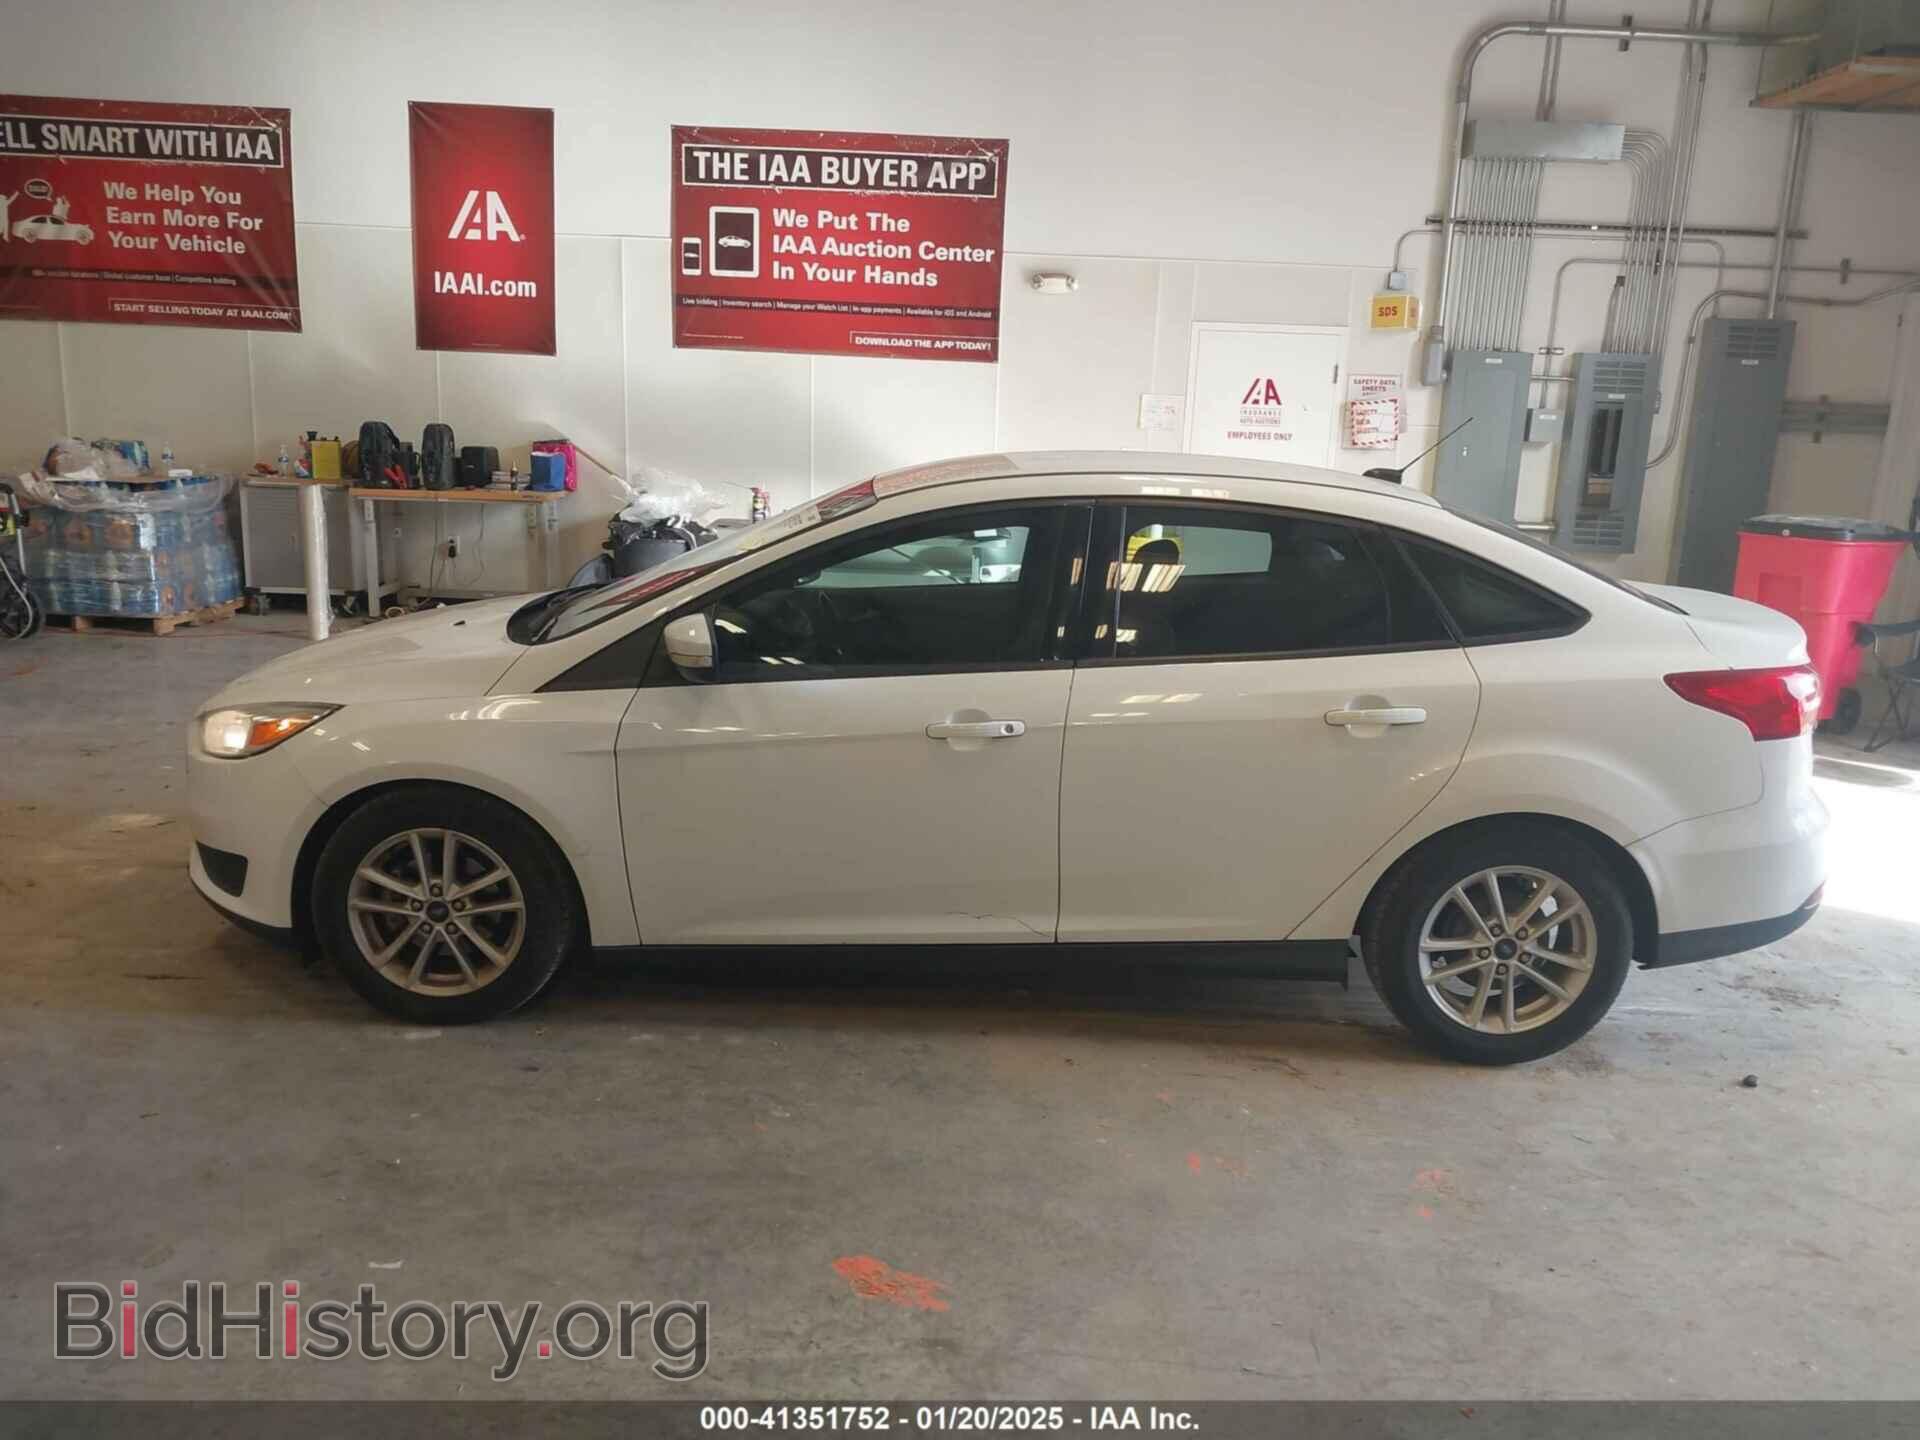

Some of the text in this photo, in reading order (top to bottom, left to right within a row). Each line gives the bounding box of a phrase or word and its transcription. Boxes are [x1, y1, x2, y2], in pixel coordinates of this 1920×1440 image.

[40, 122, 139, 154] SMART
[144, 128, 217, 157] WITH
[225, 131, 274, 160] IAA
[693, 150, 986, 191] THE IAA BUYER APP
[103, 181, 242, 206] We Help You
[106, 206, 263, 231] Earn More For
[772, 208, 910, 233] We Put The
[108, 230, 246, 255] Your Vehicle
[772, 234, 995, 263] IAA Auction Center
[434, 271, 537, 298] IAAI.com
[772, 260, 938, 287] In Your Hands
[113, 303, 144, 312] START
[148, 304, 190, 314] SELLING
[191, 306, 225, 316] TODAY
[226, 309, 238, 317] AT
[1377, 305, 1398, 317] SDS
[855, 336, 991, 351] DOWNLOAD THE APP TODAY!
[1227, 431, 1293, 441] EMPLOYEES ONLY
